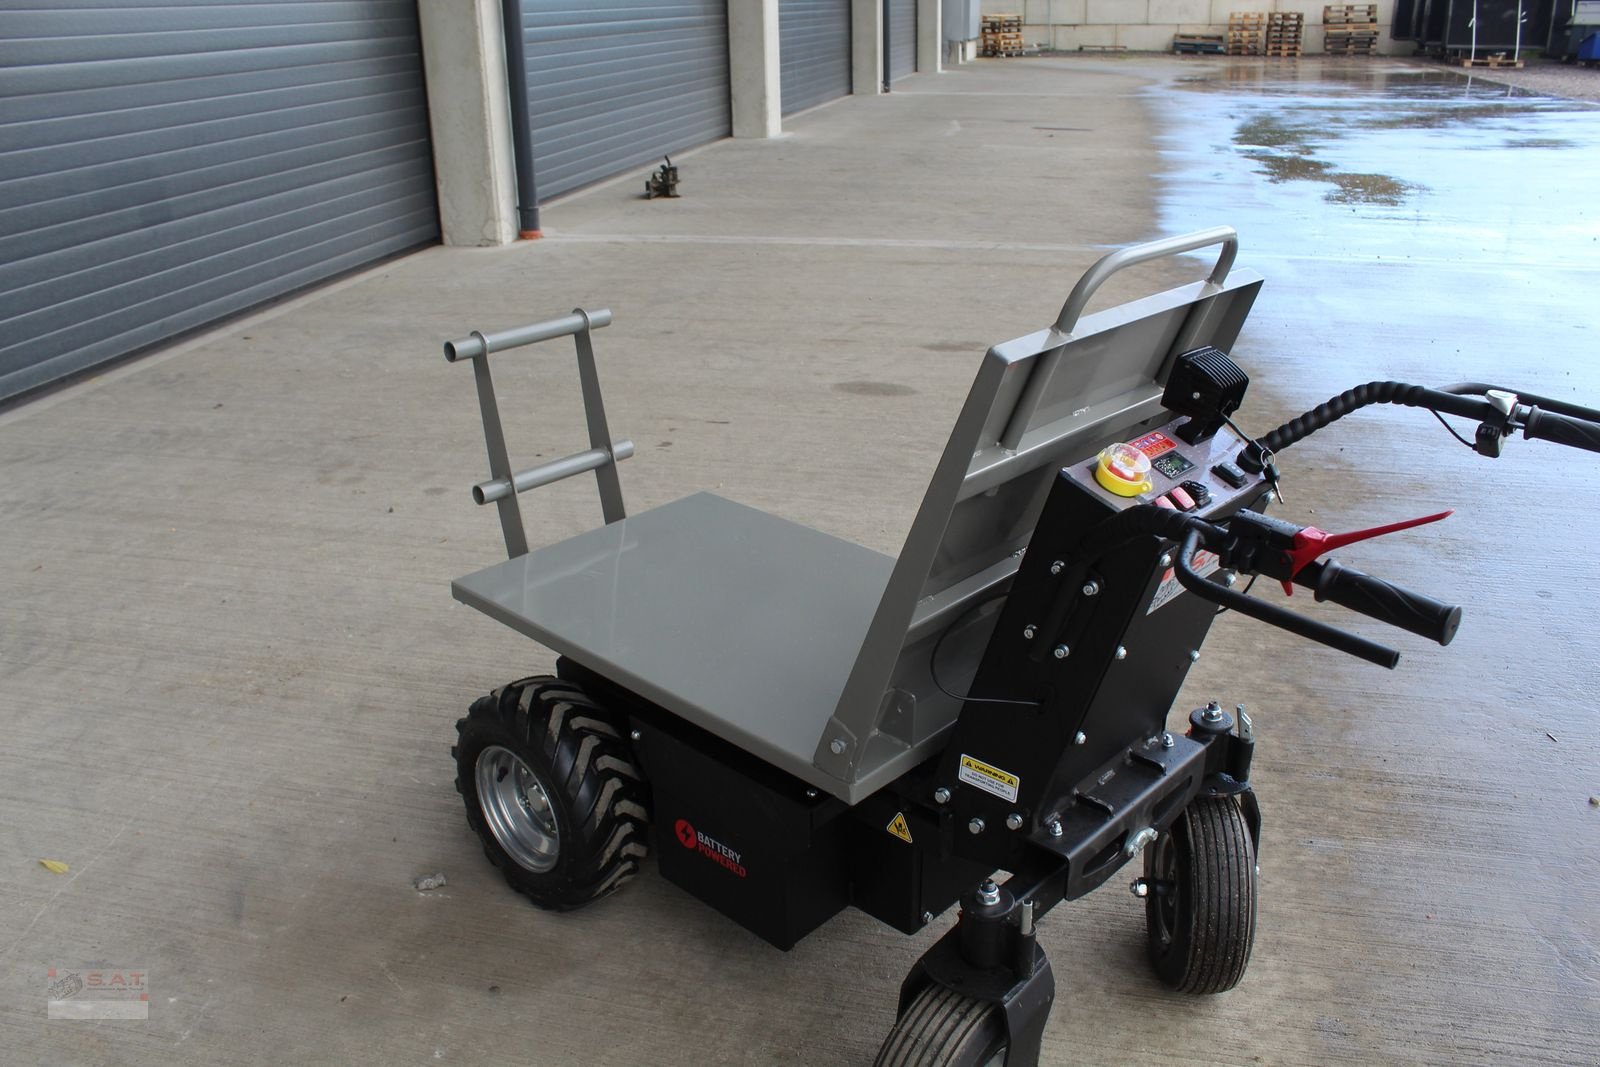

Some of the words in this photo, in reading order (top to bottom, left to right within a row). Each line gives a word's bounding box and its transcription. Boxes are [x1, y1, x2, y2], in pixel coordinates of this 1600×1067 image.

[974, 764, 1006, 781] WARNING
[697, 831, 741, 864] BATTERY
[698, 842, 747, 877] POWERED
